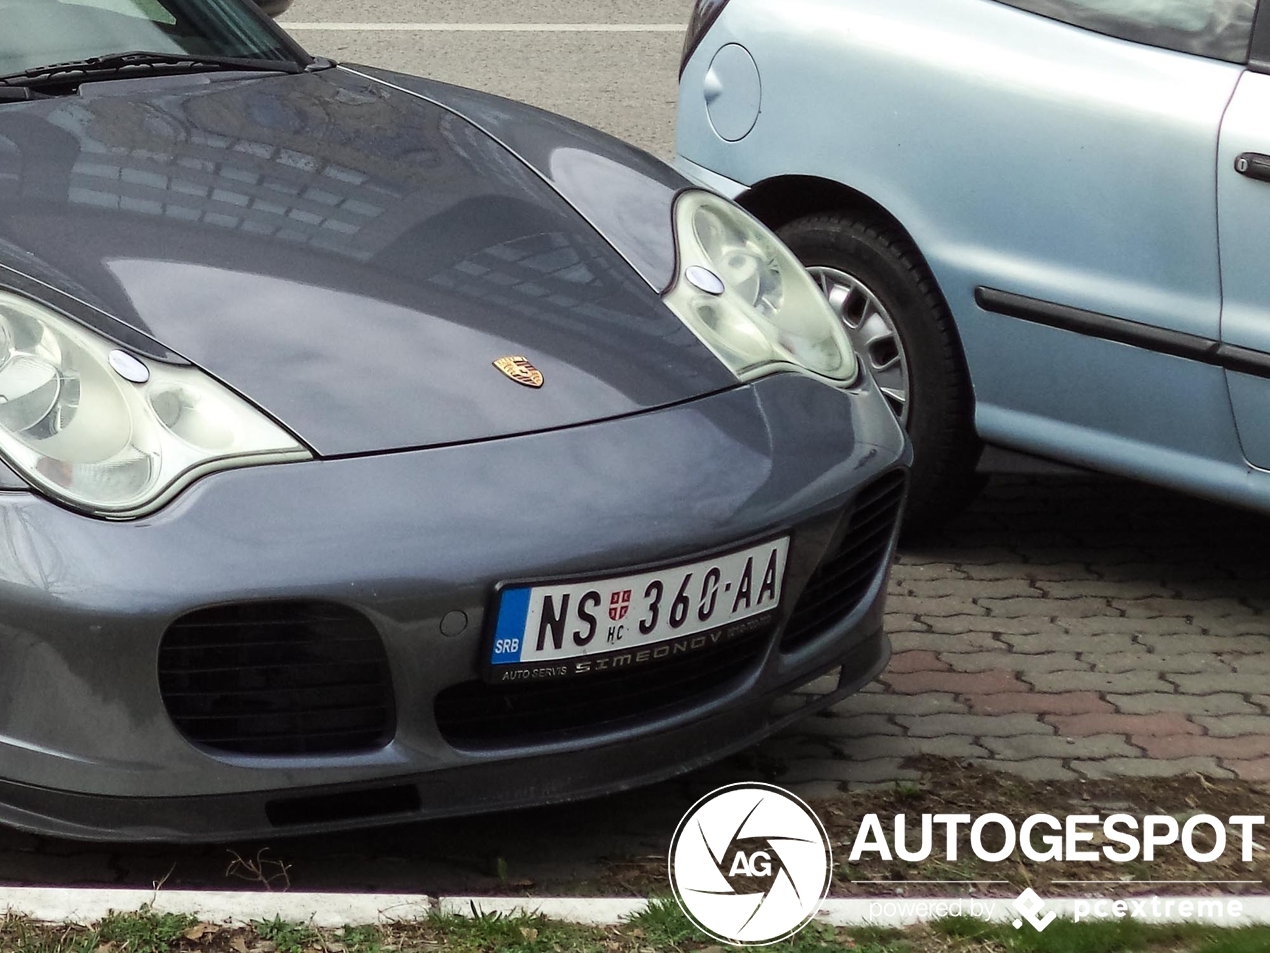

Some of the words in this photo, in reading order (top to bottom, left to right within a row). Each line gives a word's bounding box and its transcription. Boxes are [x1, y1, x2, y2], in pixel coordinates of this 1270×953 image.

[494, 638, 520, 654] SRB
[535, 590, 602, 652] NS
[502, 669, 530, 681] AUTO
[531, 666, 567, 678] SERVIS
[574, 631, 722, 674] SIMEONOV
